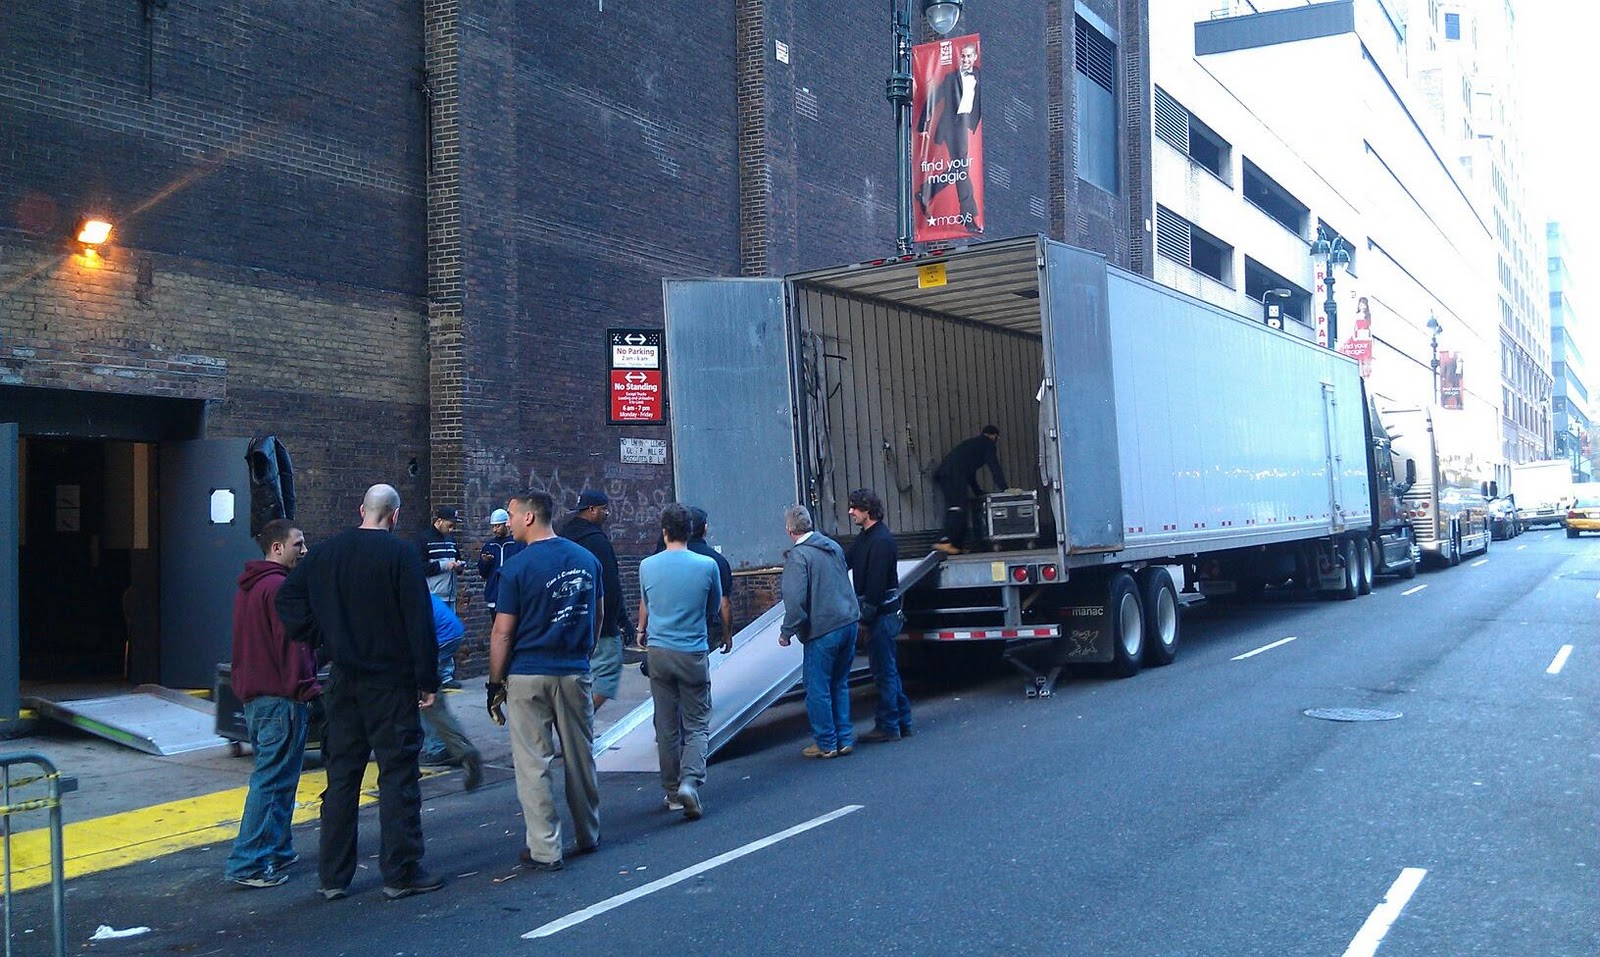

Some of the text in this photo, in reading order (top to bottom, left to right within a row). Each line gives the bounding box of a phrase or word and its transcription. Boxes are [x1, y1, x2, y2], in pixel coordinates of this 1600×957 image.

[921, 157, 973, 173] find your
[928, 168, 968, 185] magic
[937, 212, 973, 228] macy's
[629, 347, 654, 356] Parking
[614, 383, 657, 392] No Standing
[1072, 608, 1103, 616] manac
